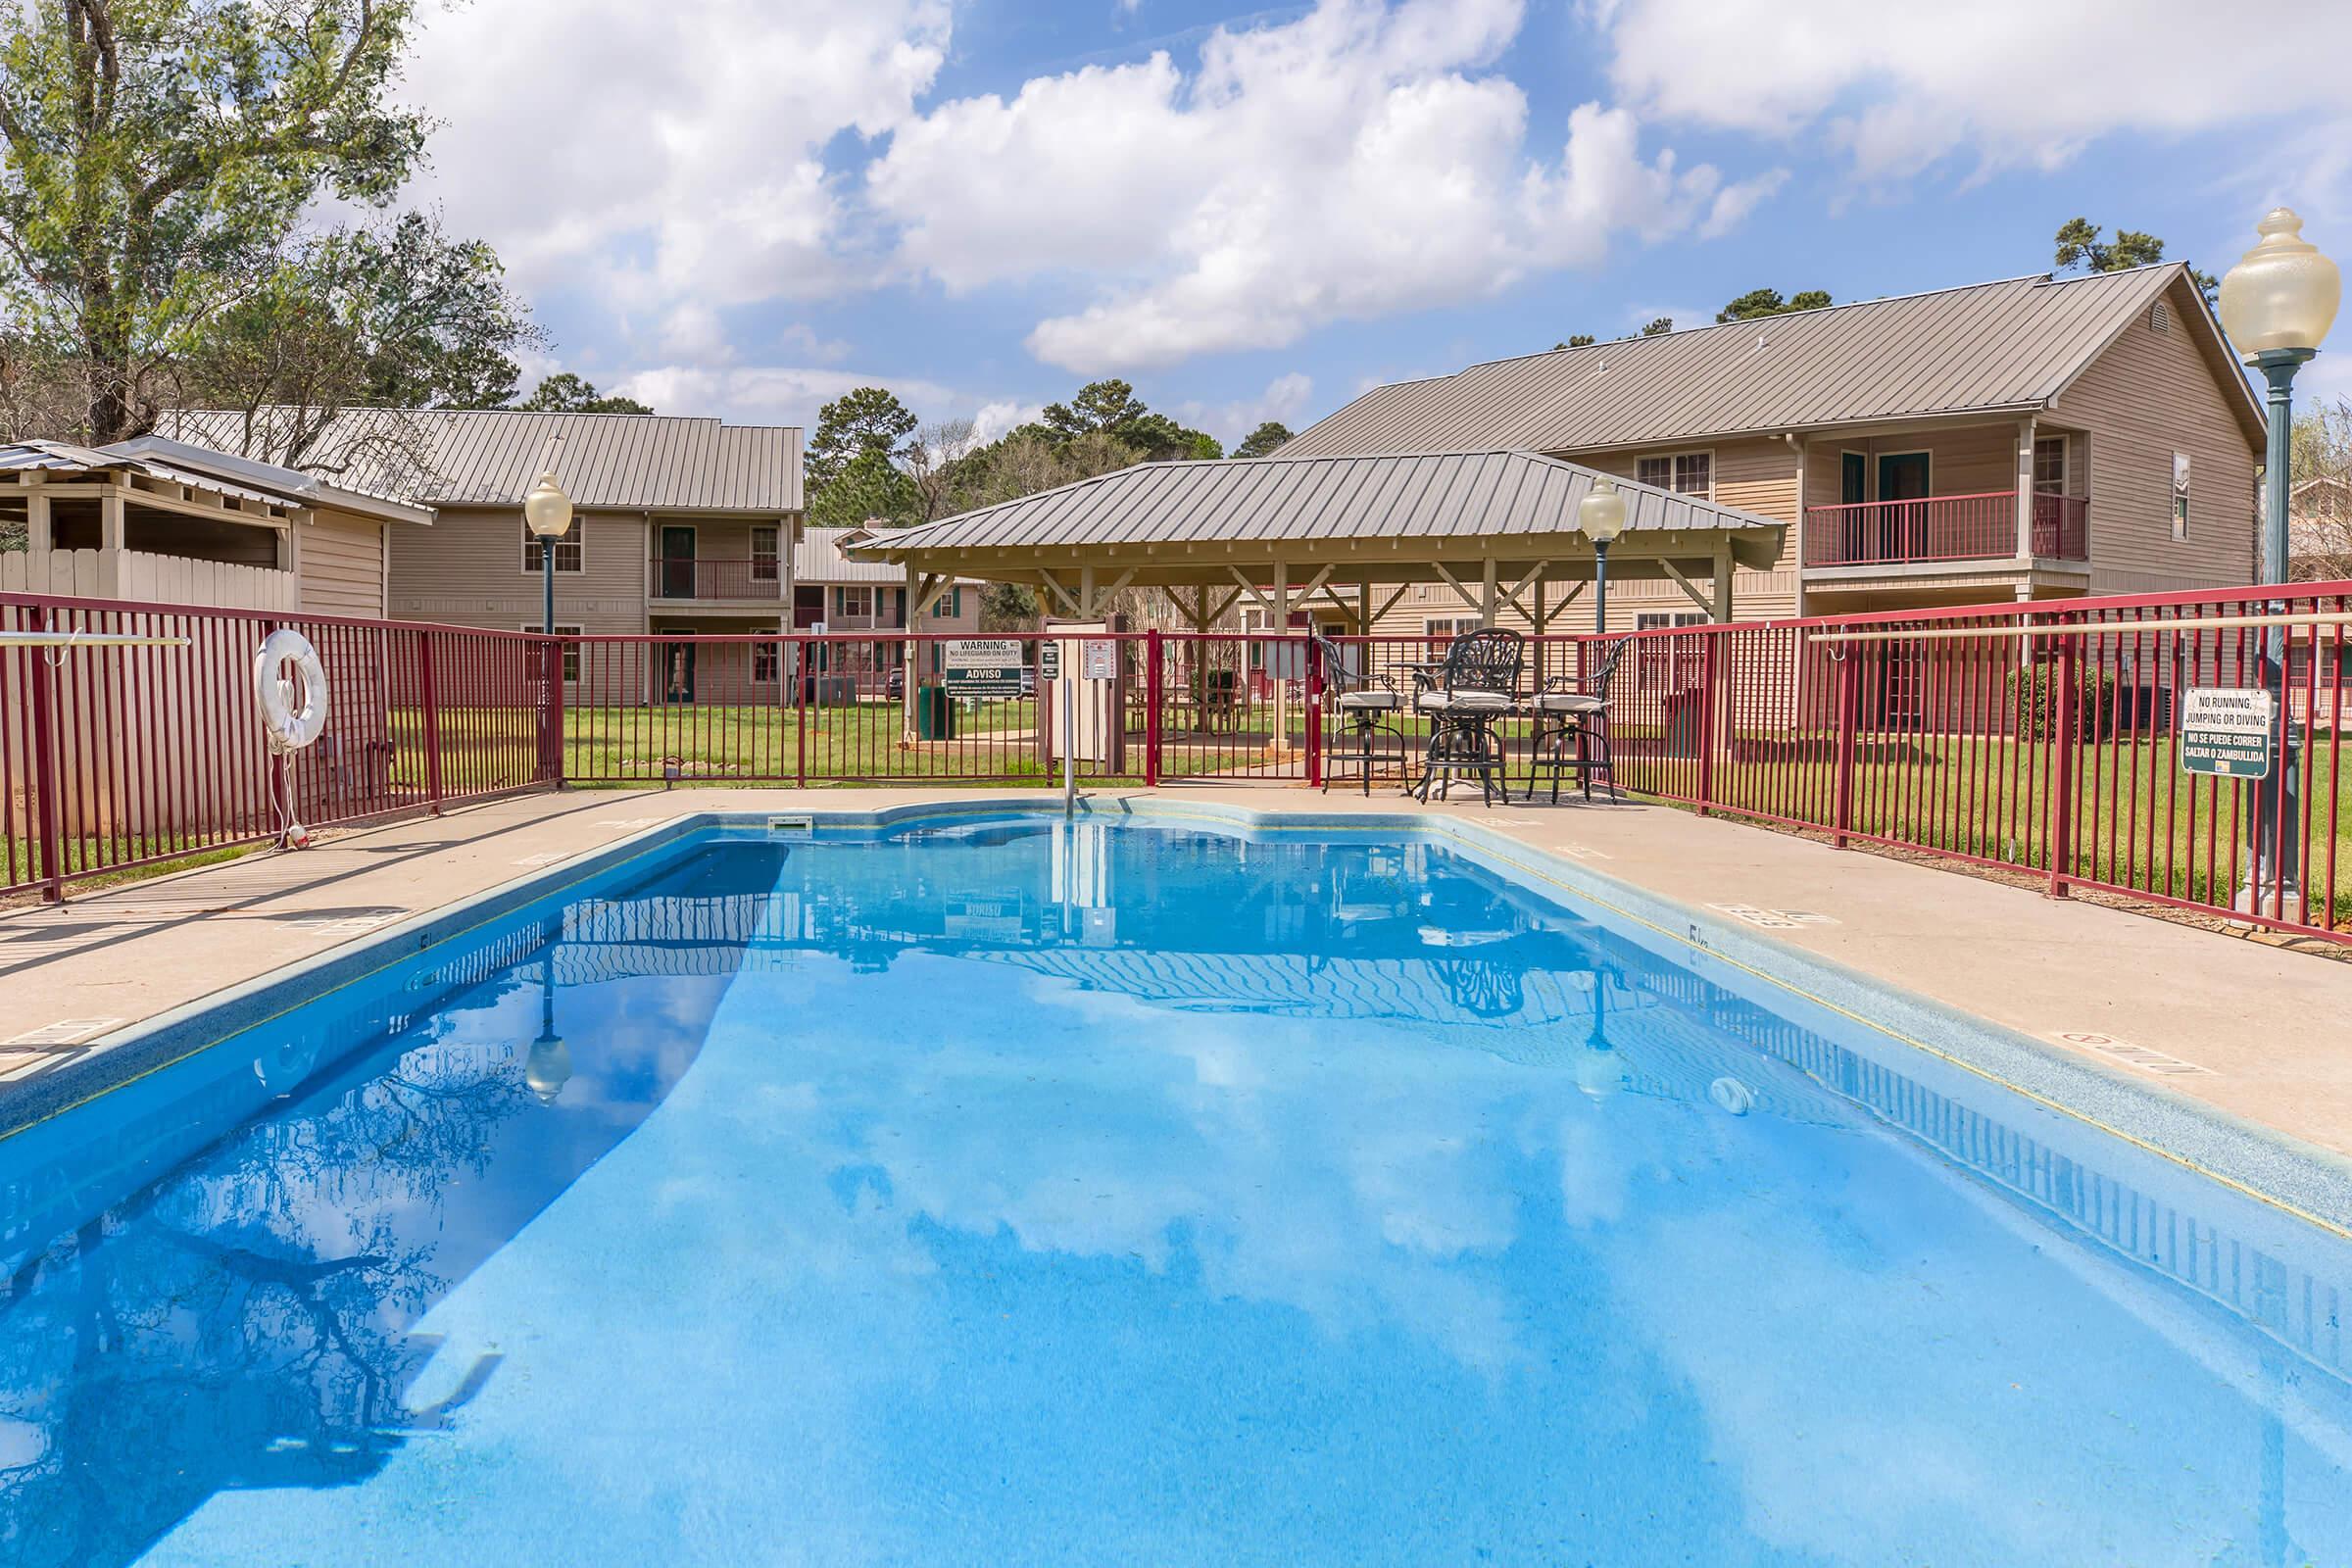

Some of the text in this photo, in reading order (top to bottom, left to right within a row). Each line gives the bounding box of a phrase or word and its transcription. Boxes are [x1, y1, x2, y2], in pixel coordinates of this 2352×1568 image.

[960, 641, 1006, 650] WARNING
[965, 669, 1002, 679] ADVISO
[2198, 697, 2252, 710] NO RUNNING,
[2185, 712, 2266, 727] JUMPING OR DIVING
[2187, 732, 2263, 748] NO SE PUEDE CORRER
[2184, 747, 2265, 762] SALTAR O ZAMBULLIDA
